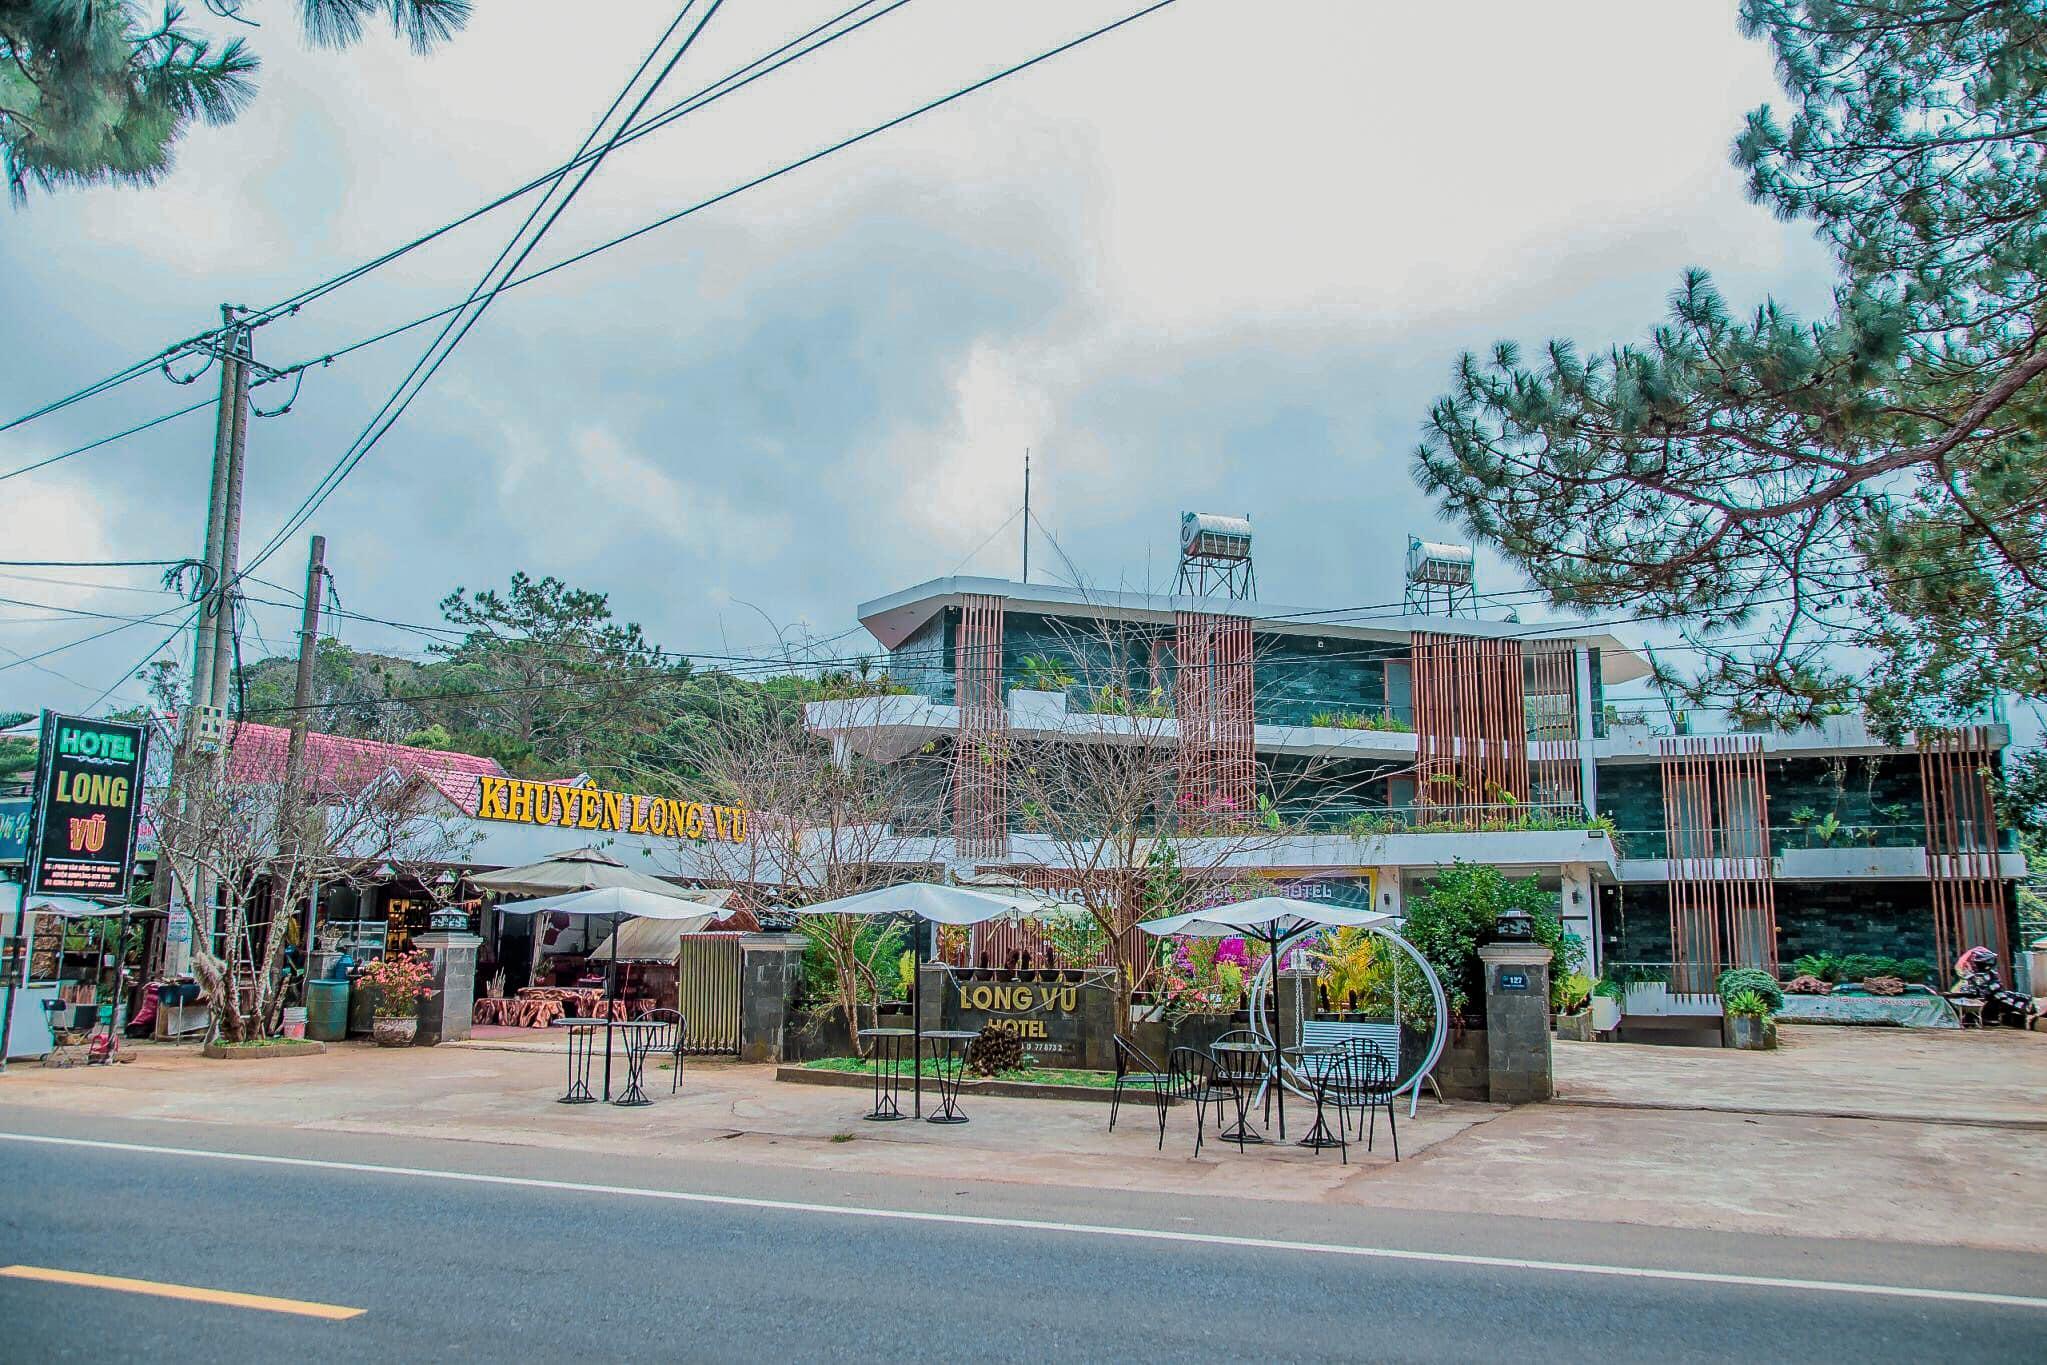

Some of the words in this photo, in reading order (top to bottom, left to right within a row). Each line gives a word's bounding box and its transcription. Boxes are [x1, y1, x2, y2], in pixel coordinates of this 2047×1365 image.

[60, 728, 134, 760] HOTEL
[56, 771, 129, 808] LONG
[479, 776, 624, 831] KHUYÊN
[630, 794, 705, 839] LONG
[70, 813, 106, 852] VŨ
[960, 985, 1033, 1011] LONG
[1041, 981, 1078, 1012] VŨ
